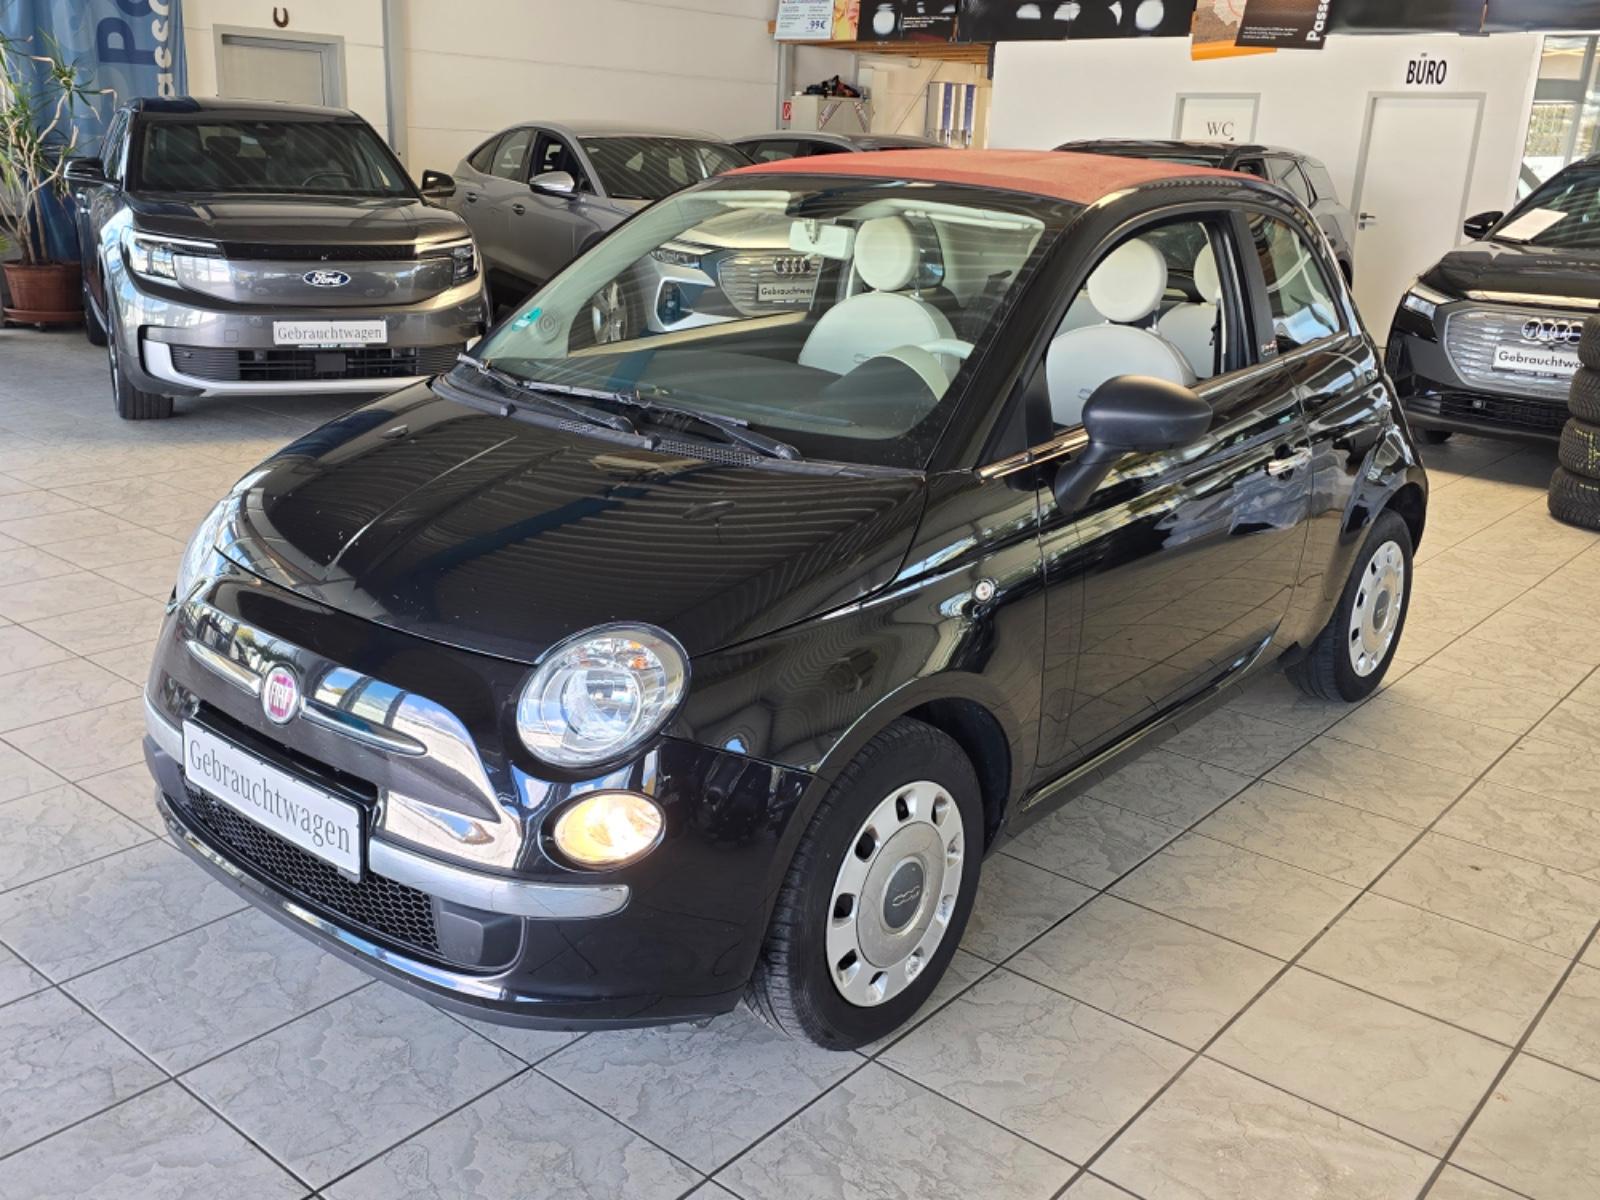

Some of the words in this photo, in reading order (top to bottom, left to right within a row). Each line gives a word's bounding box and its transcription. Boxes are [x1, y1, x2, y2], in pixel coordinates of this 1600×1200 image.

[1406, 52, 1447, 85] BÜRO
[1207, 121, 1233, 136] WC
[311, 272, 342, 285] Ford
[278, 326, 382, 341] Gebrauchtwagen
[189, 739, 351, 854] Gebrauchtwagen
